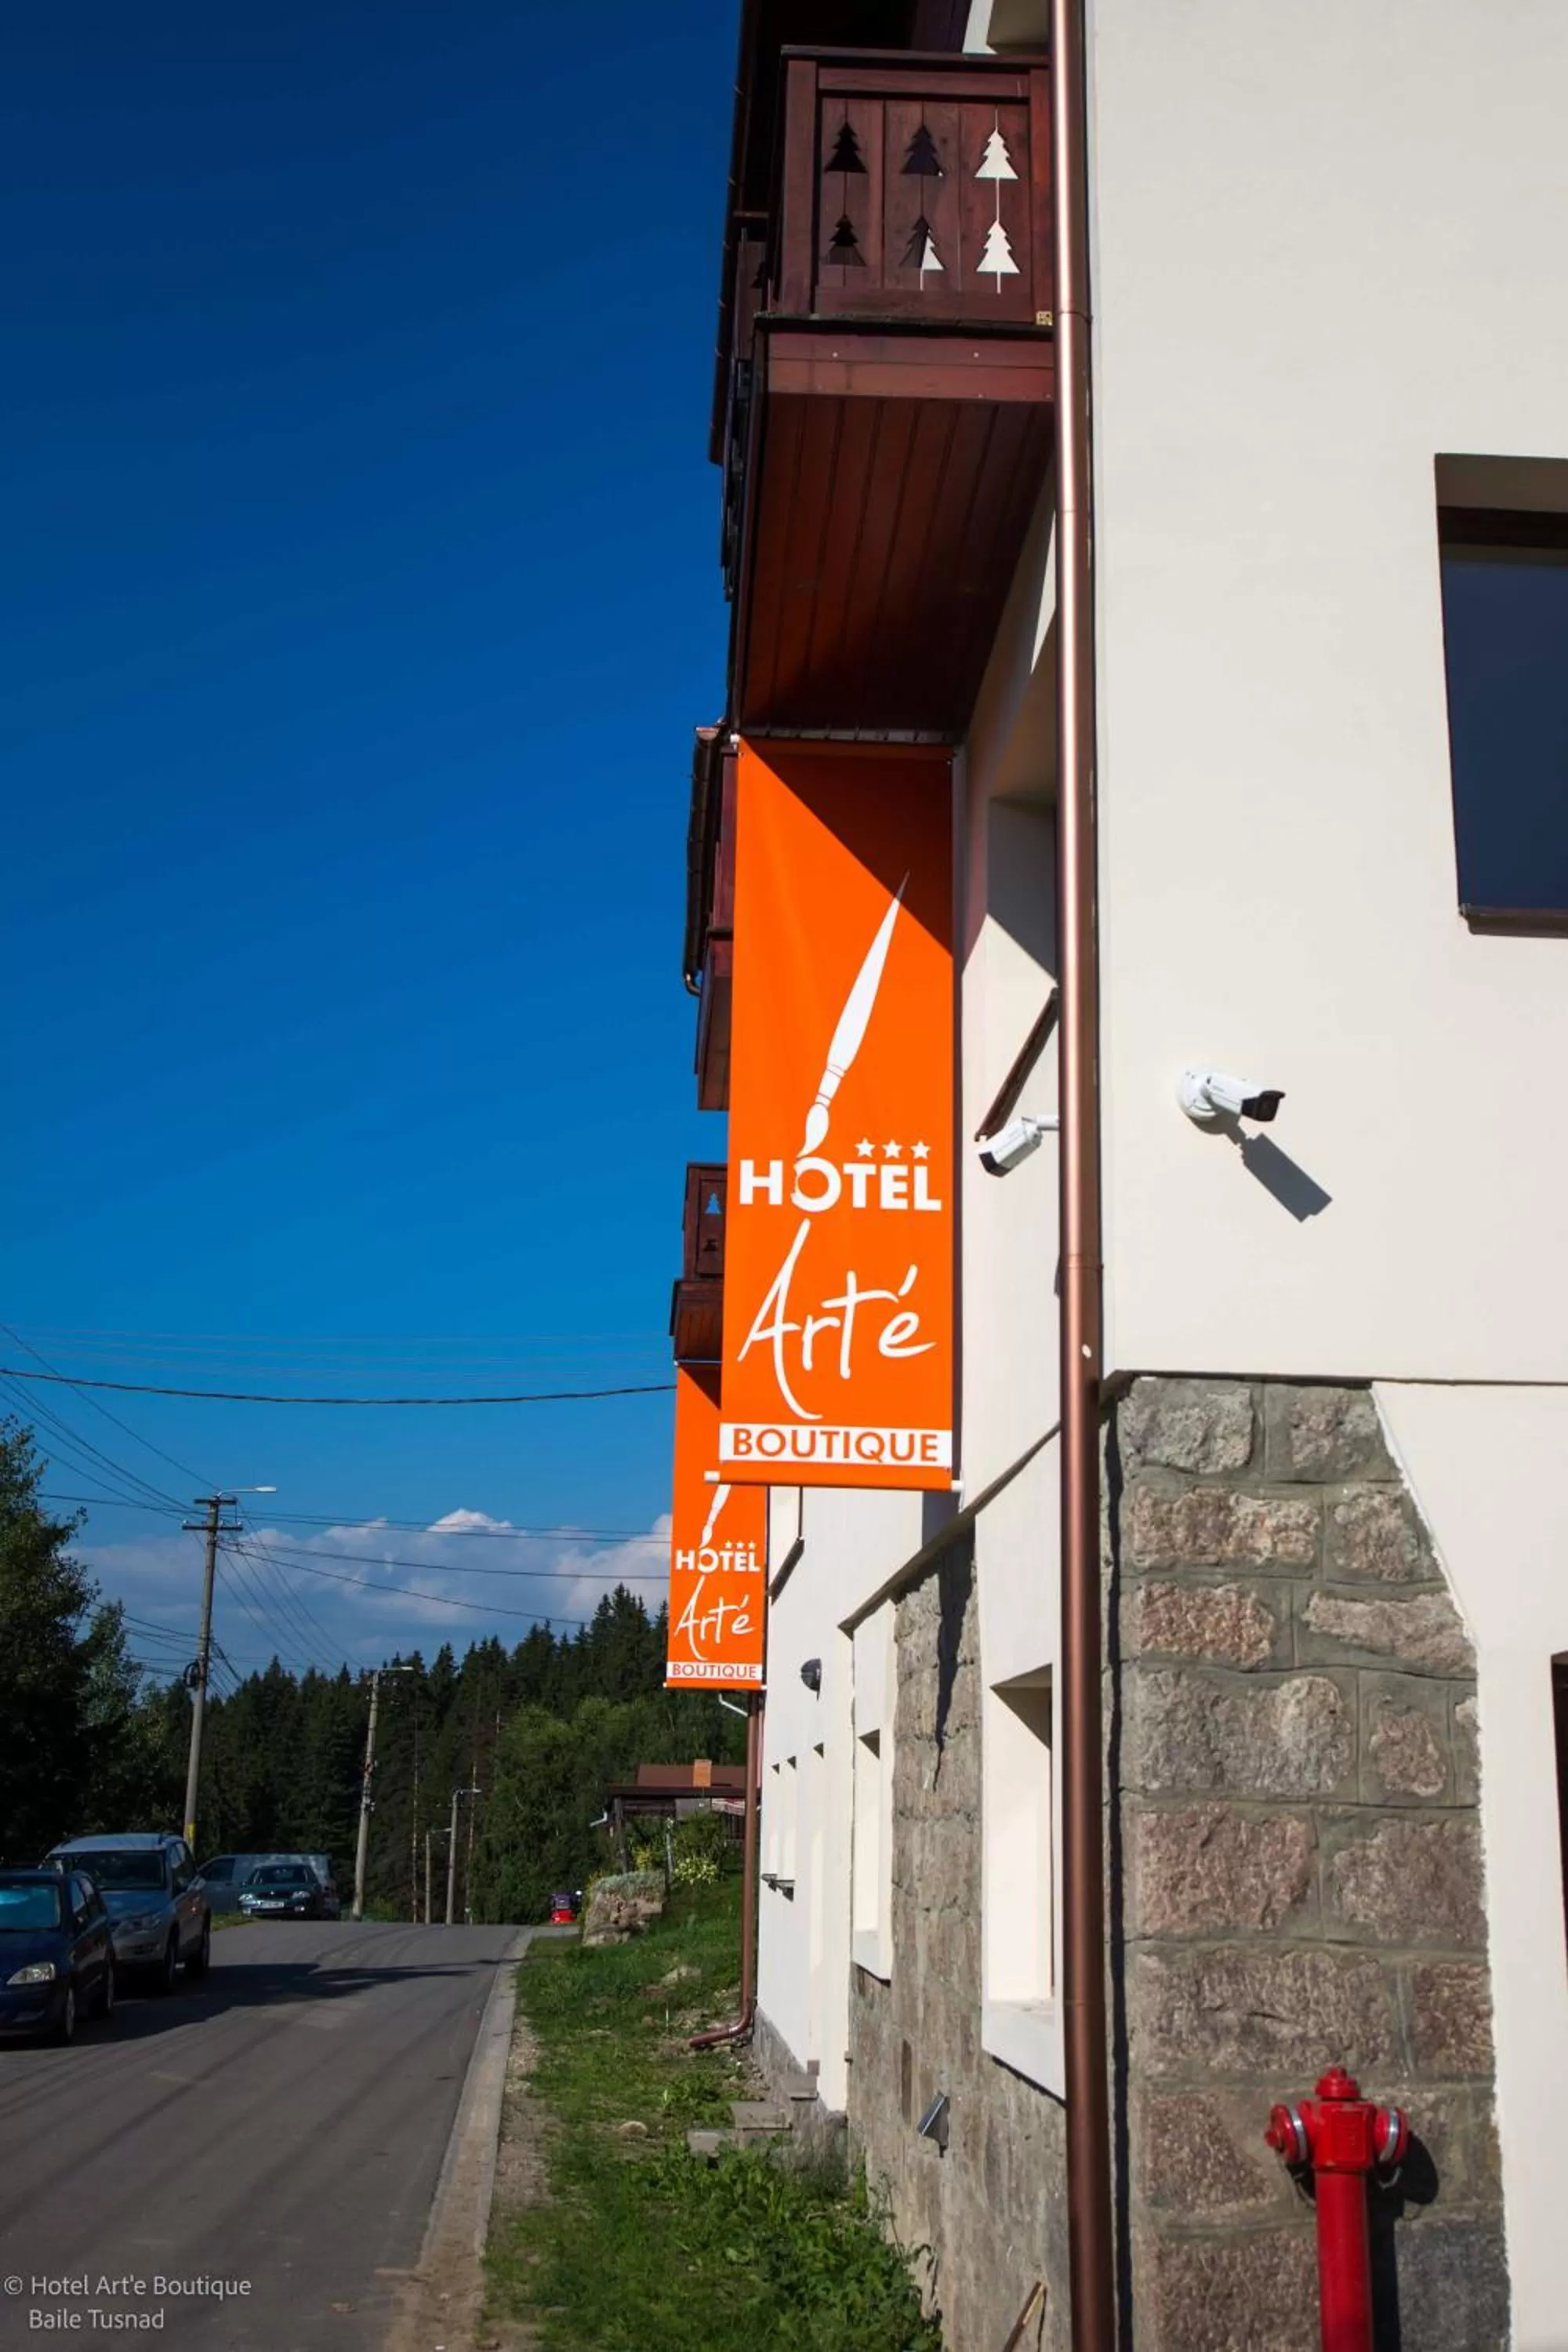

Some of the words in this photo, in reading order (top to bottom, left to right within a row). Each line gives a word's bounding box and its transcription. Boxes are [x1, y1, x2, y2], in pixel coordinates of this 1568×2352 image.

[739, 1156, 942, 1212] HOTEL
[732, 1427, 938, 1463] BOUTIQUE
[676, 1548, 760, 1573] HOTEL
[672, 1663, 757, 1679] BOUTIQUE
